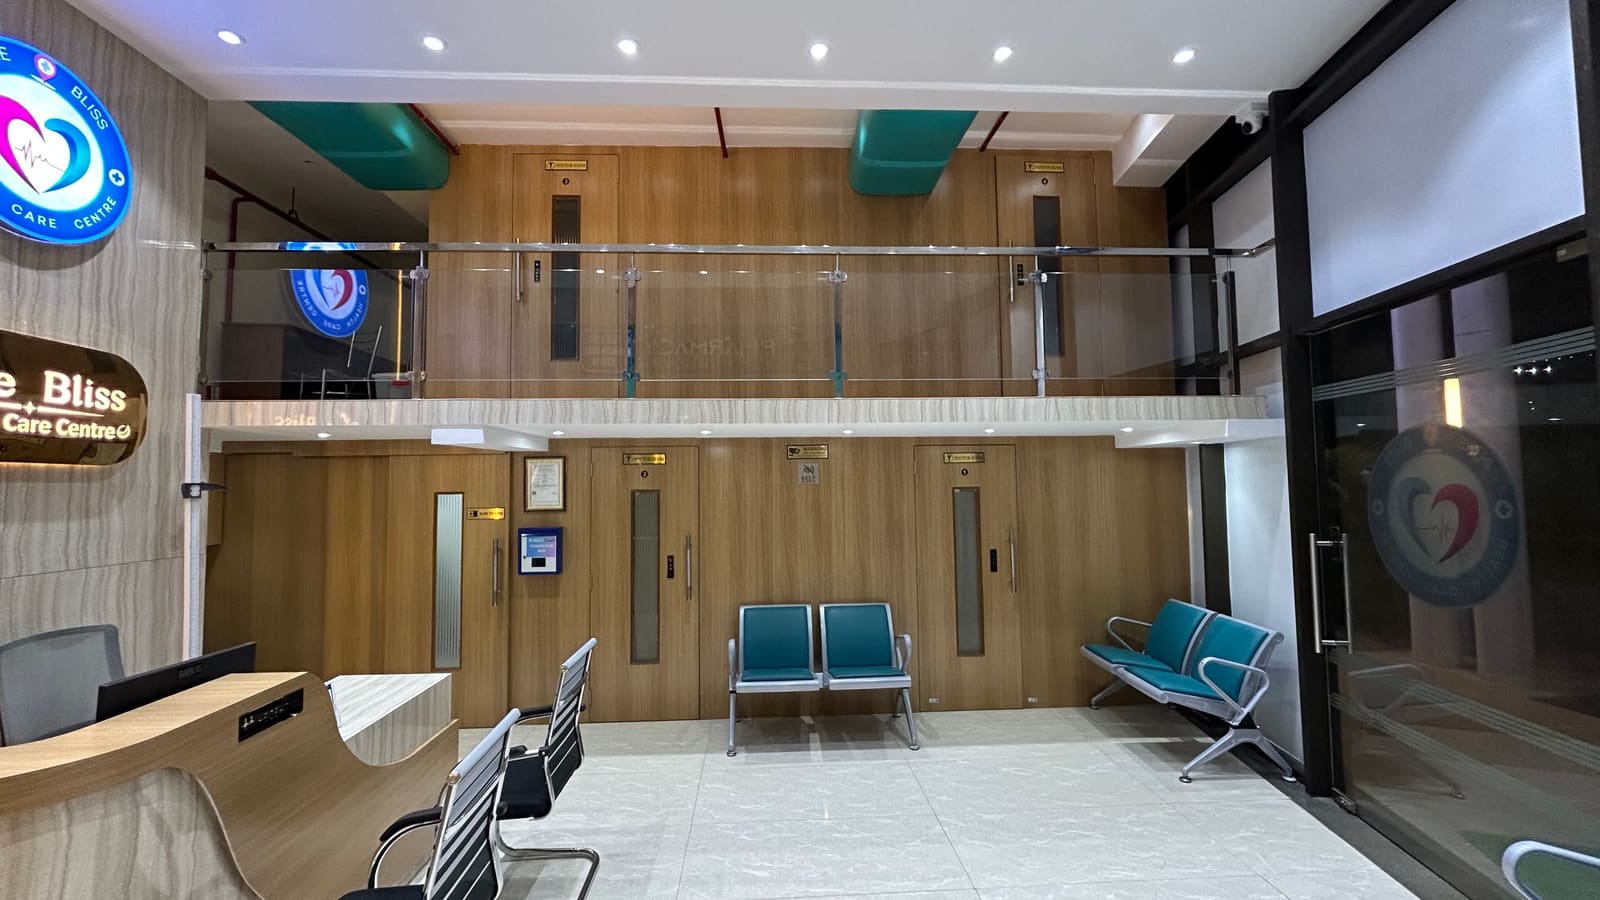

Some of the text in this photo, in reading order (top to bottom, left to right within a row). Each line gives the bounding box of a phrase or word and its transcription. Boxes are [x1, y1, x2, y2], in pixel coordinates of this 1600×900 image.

[71, 85, 109, 130] BLISS
[11, 195, 117, 230] CARE CENTRE
[43, 370, 127, 412] Bliss
[2, 413, 116, 440] Care Centre
